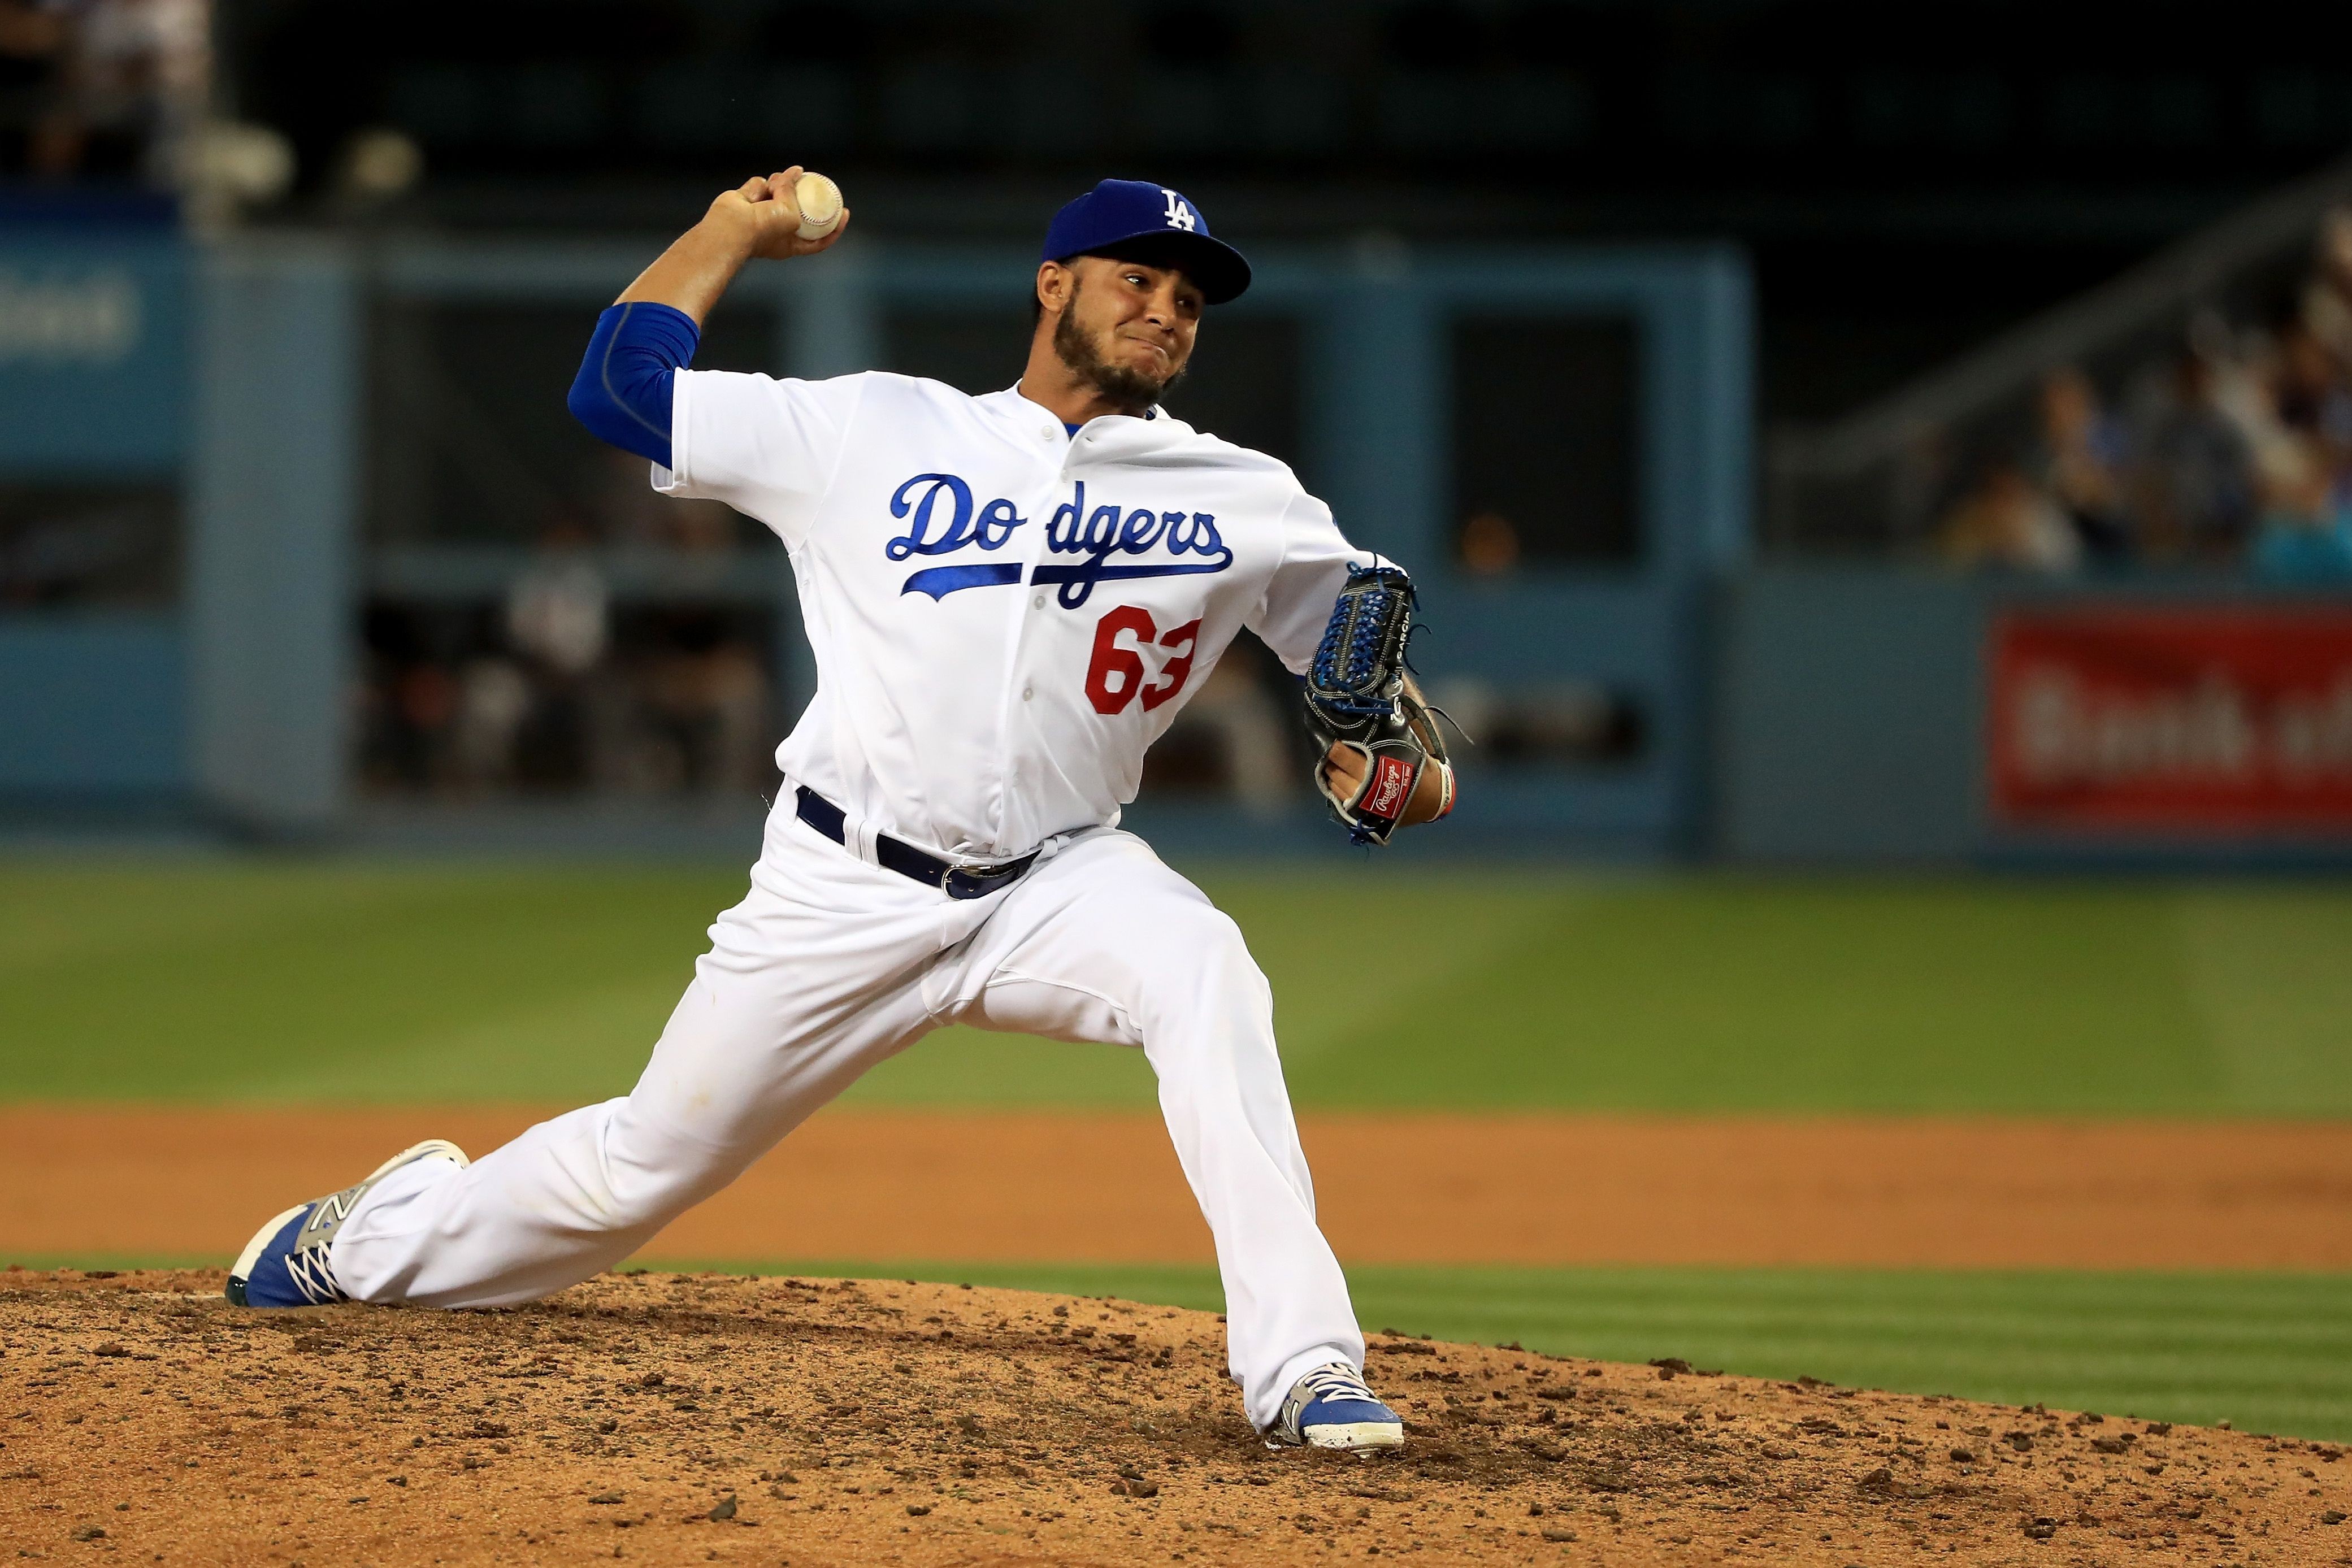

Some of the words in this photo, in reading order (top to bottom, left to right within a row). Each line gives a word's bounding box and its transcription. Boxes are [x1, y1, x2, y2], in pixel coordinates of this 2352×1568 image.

[1161, 189, 1195, 232] LA
[886, 473, 1233, 609] Dodgers
[1085, 605, 1203, 715] 63
[1396, 611, 1410, 660] GARCIA
[1375, 764, 1400, 811] Rawlings
